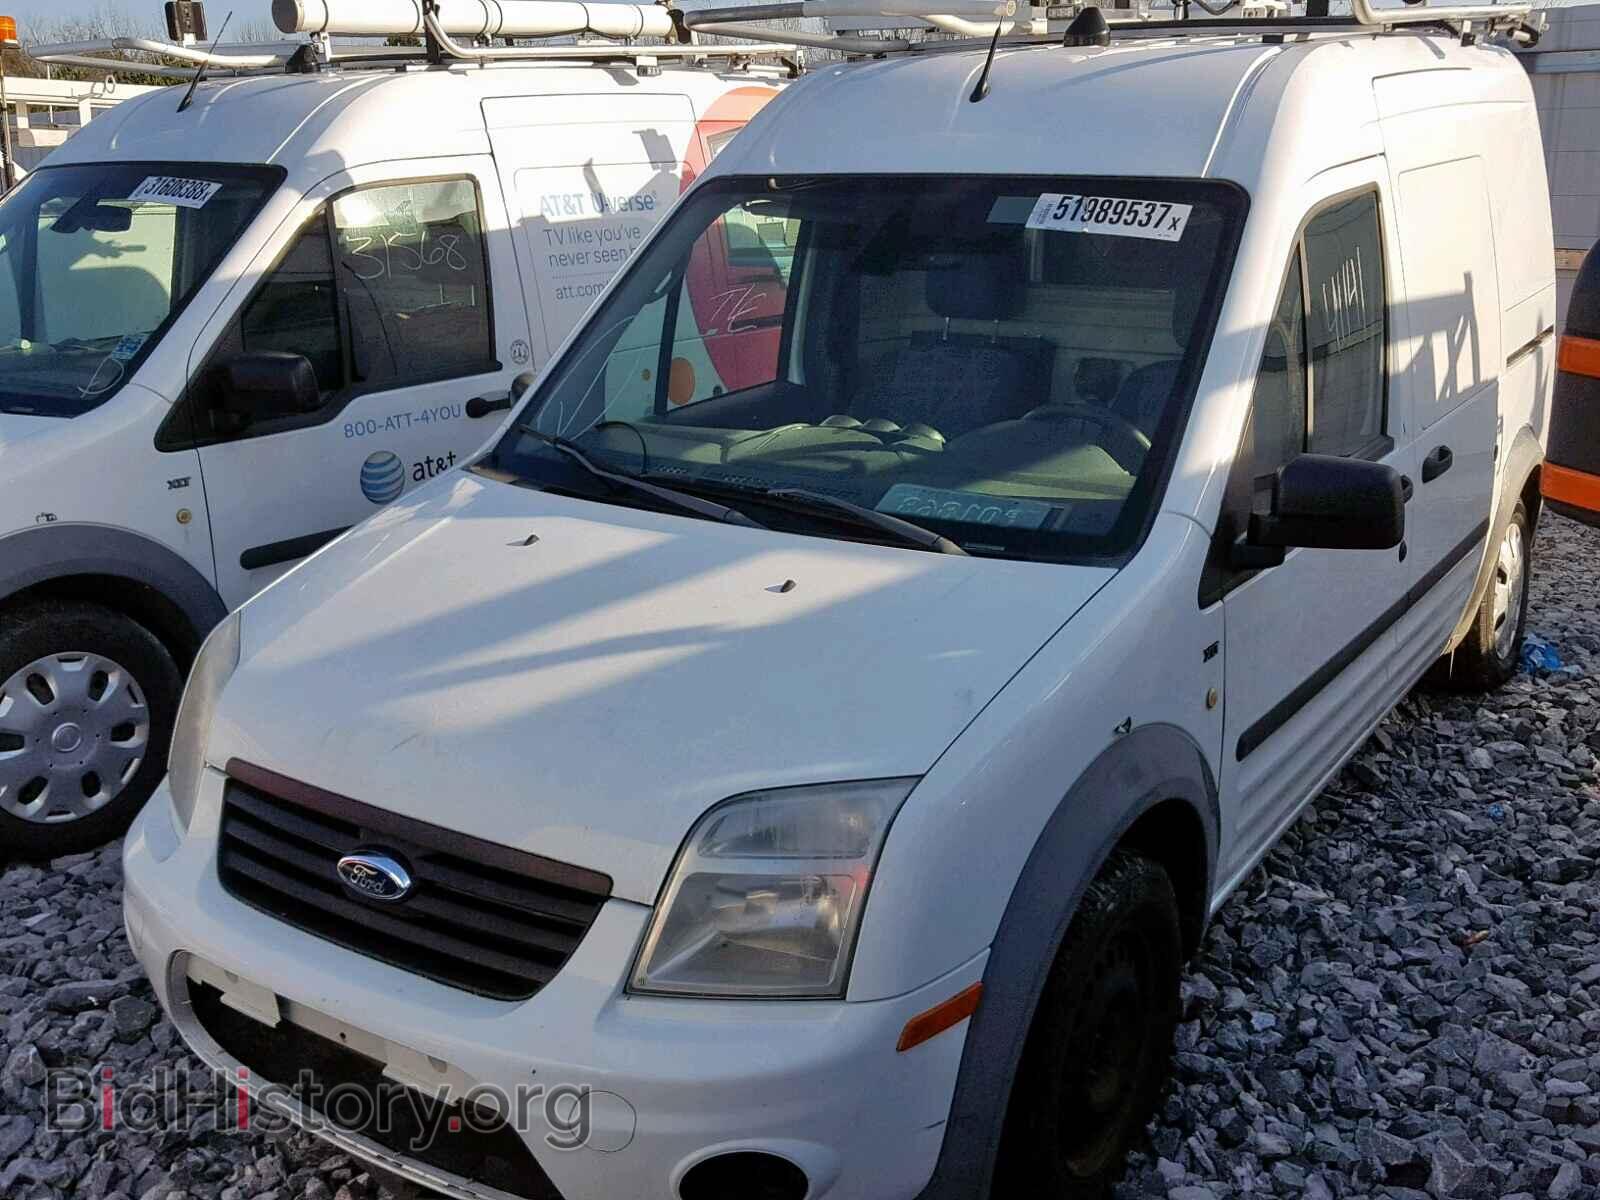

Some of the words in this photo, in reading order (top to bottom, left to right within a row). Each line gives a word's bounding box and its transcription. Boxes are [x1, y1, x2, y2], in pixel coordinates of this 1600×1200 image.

[541, 193, 584, 216] AT&T
[543, 227, 564, 246] TV
[568, 226, 592, 243] like
[595, 224, 640, 246] you've
[549, 250, 593, 267] never
[594, 247, 629, 264] seen
[344, 404, 461, 438] 800-ATT-4YOU
[413, 451, 456, 481] at&t
[351, 864, 385, 893] Ford
